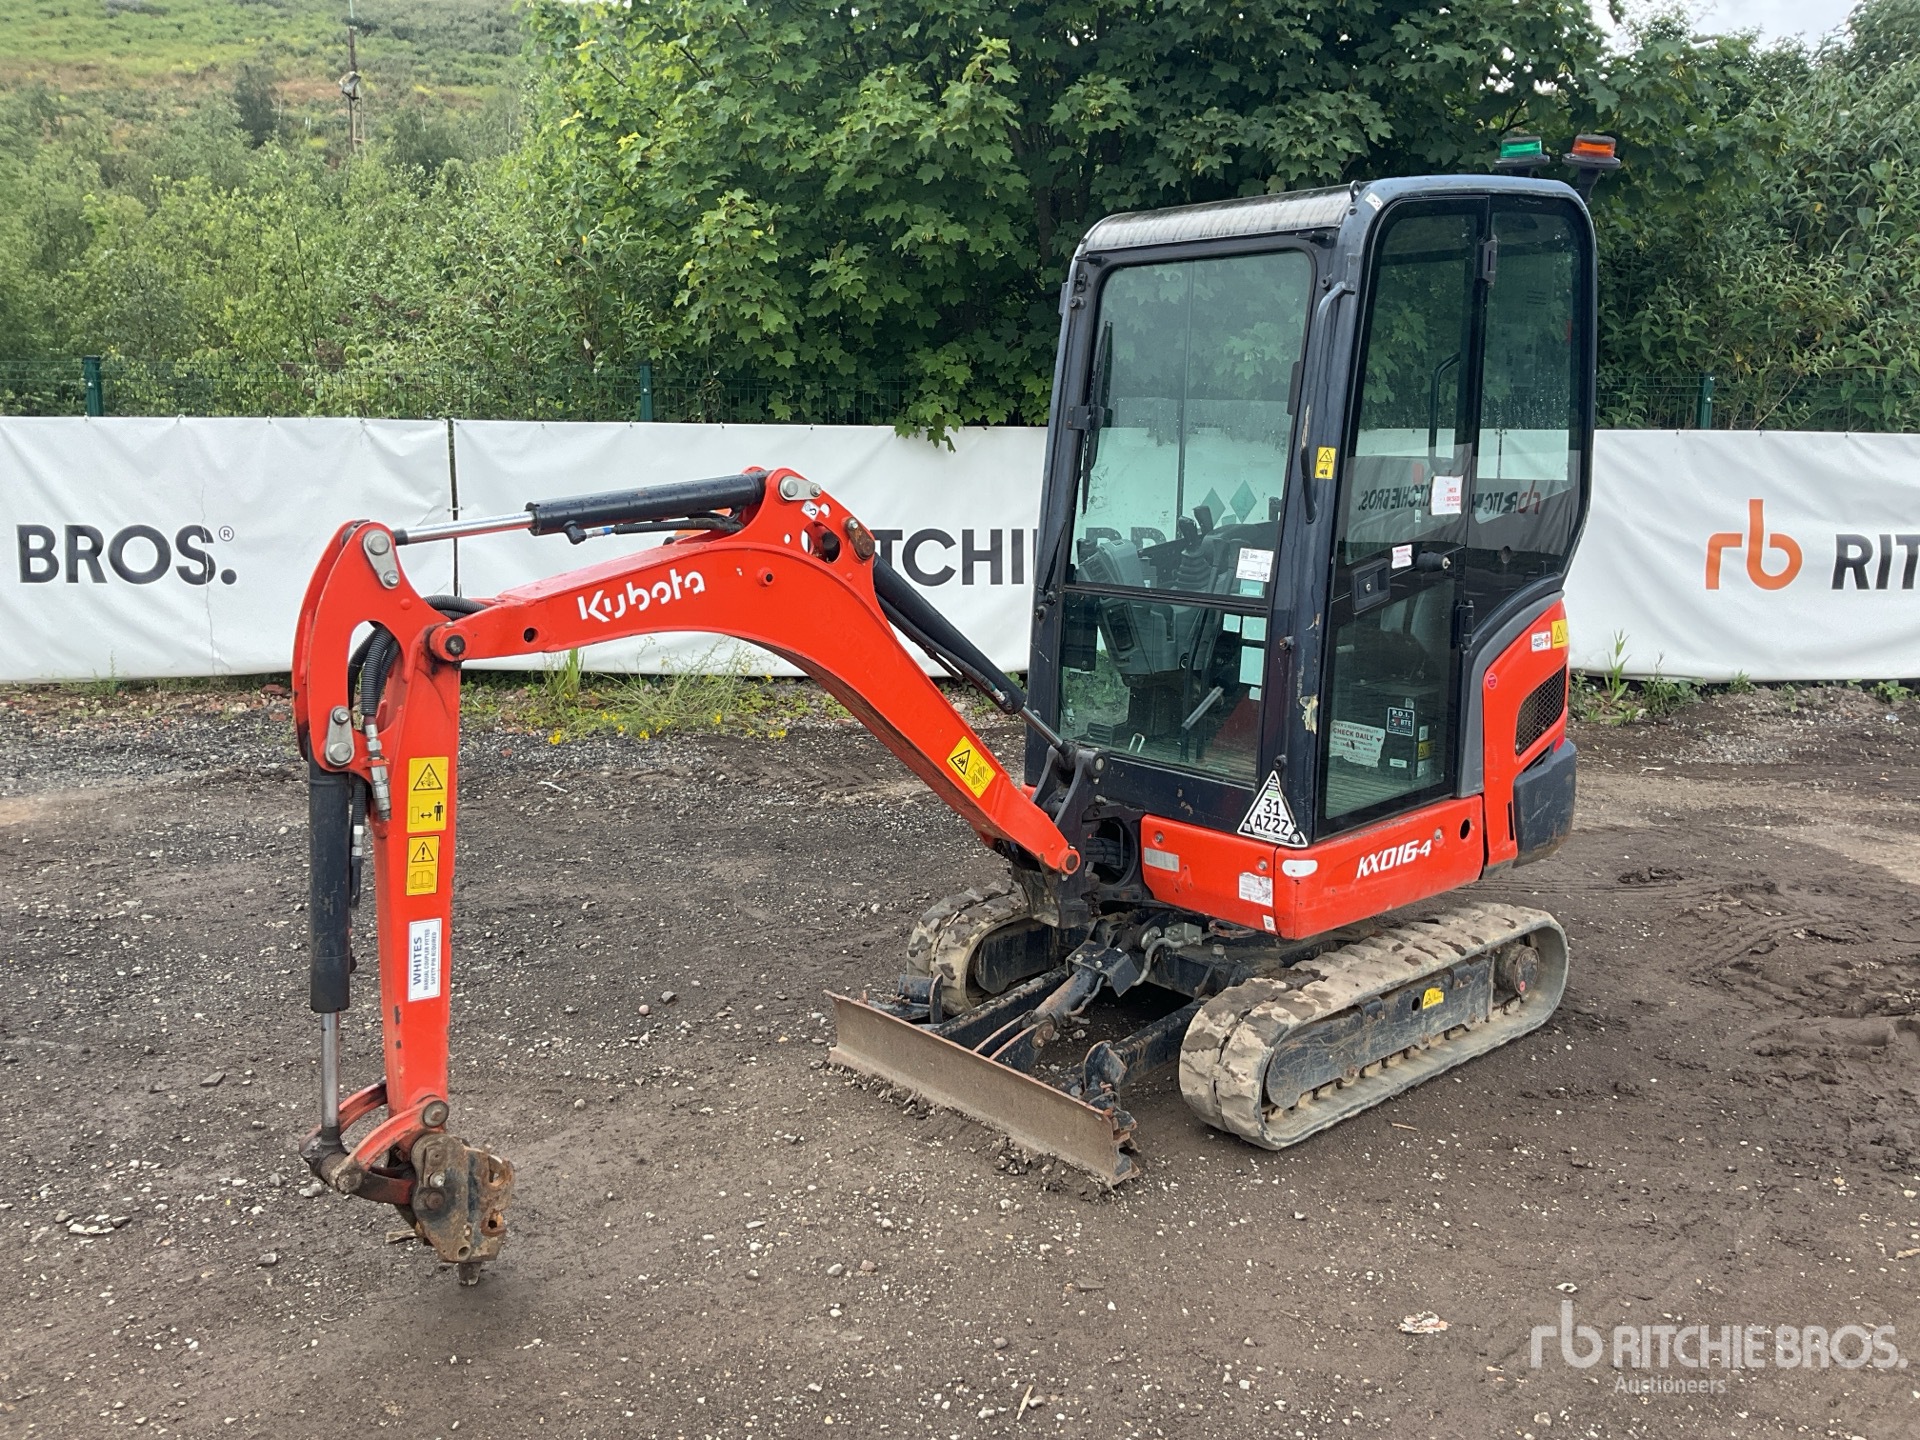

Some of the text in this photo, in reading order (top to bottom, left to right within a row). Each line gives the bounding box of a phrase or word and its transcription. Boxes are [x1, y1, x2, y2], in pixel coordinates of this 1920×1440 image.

[870, 527, 1038, 586] TCHI
[1705, 498, 1920, 590] rb RIT
[577, 568, 706, 623] Kubota
[1332, 728, 1354, 737] CHECK
[1355, 731, 1374, 741] DAILY
[1263, 797, 1281, 817] 31
[1356, 839, 1432, 879] KX016-4
[413, 937, 422, 986] WHITES
